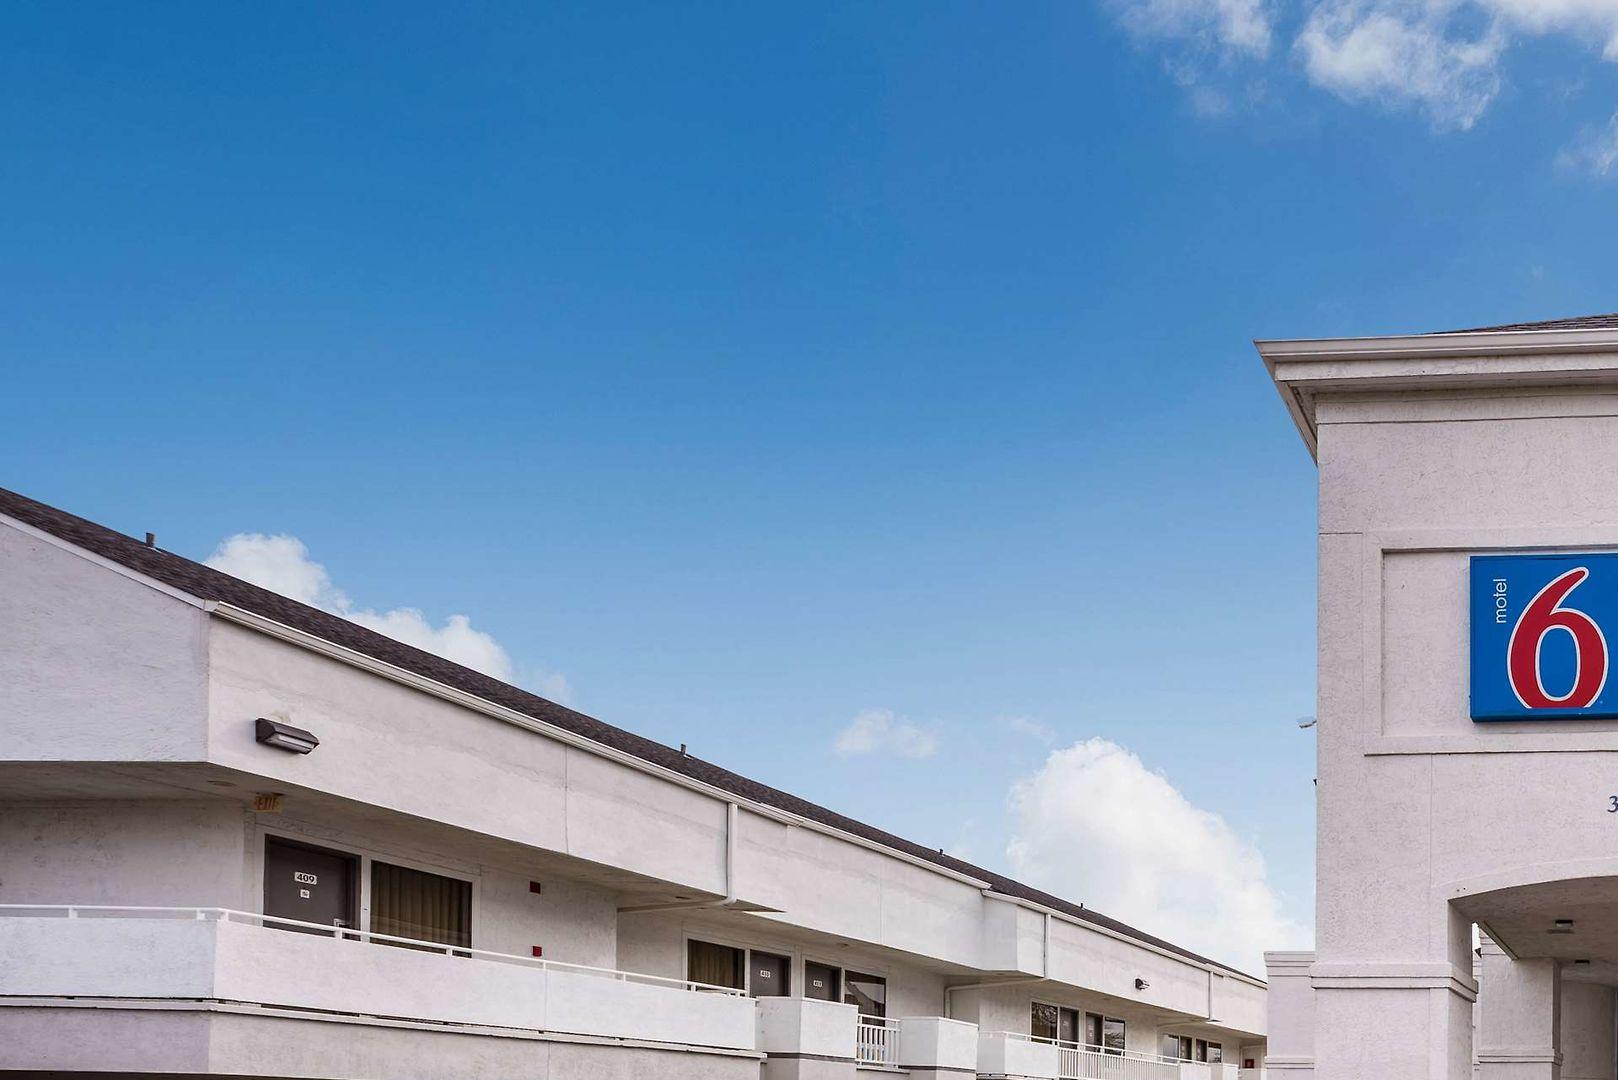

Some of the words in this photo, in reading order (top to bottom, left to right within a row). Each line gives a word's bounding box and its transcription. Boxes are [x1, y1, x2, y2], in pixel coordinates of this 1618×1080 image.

[1492, 578, 1508, 624] motel
[1507, 566, 1609, 709] 6
[296, 873, 316, 884] 409
